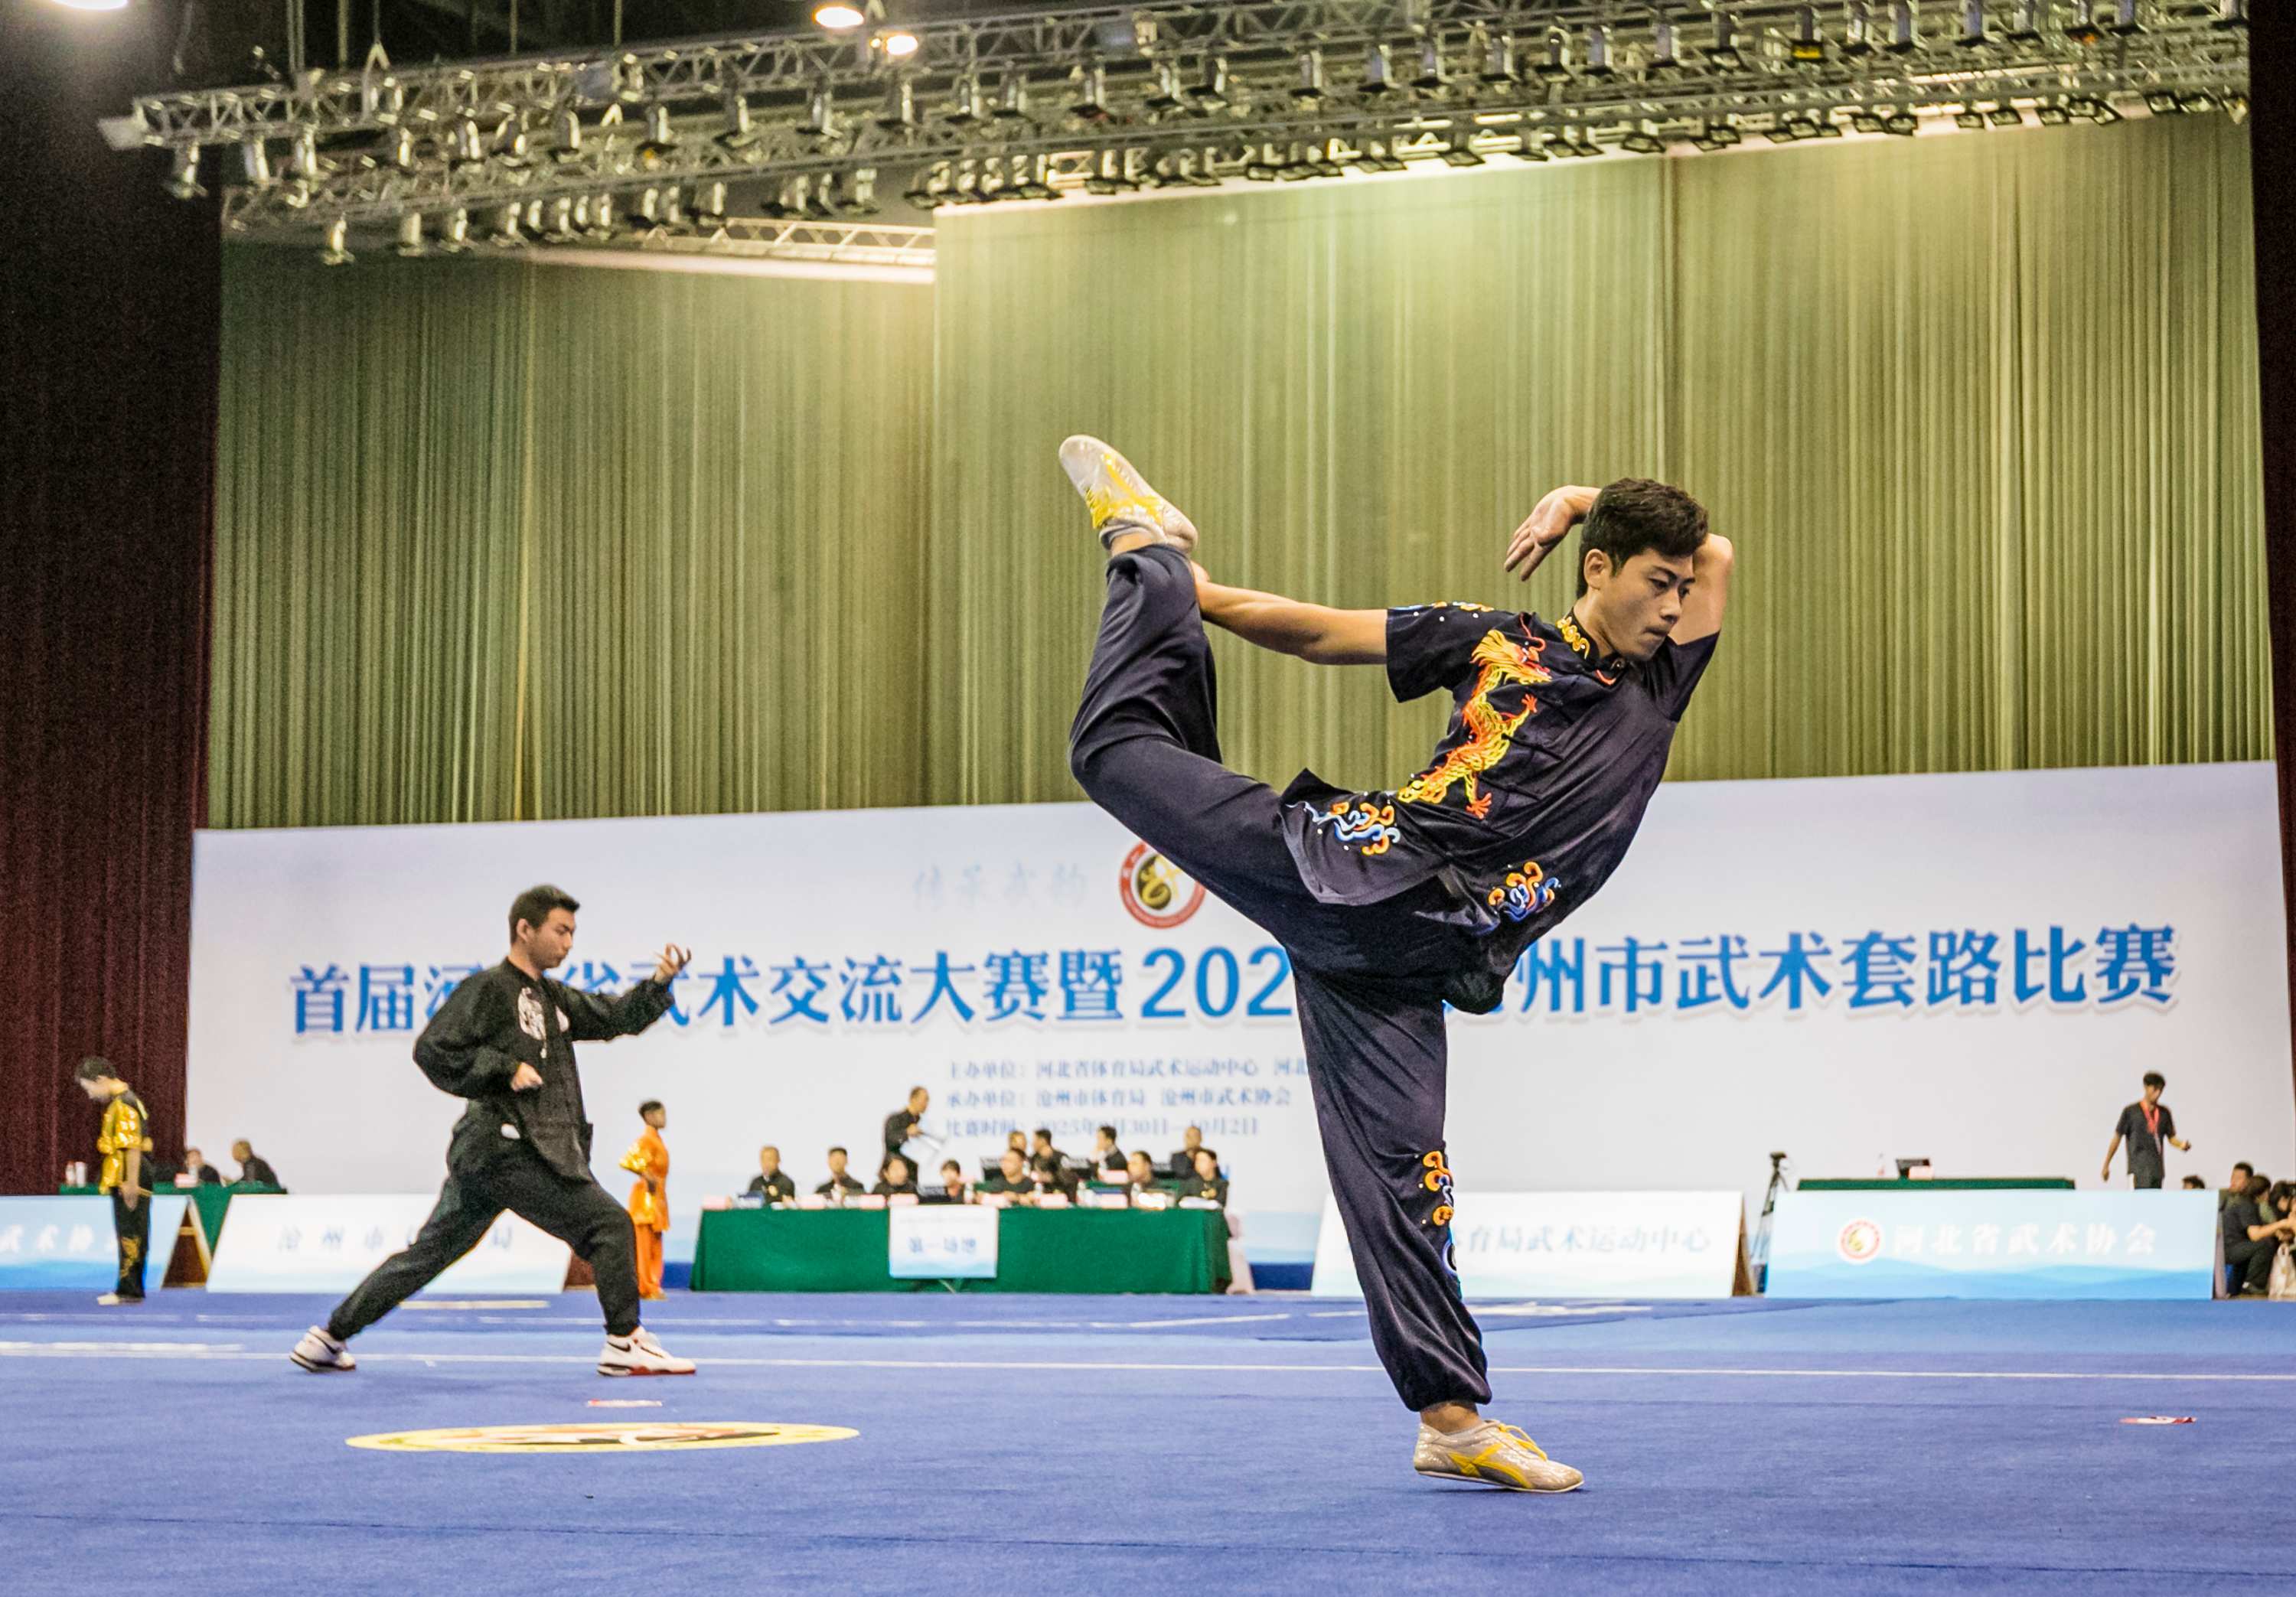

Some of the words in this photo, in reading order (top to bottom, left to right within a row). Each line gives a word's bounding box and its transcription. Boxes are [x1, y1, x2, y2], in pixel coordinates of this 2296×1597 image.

[278, 1226, 514, 1252] 沧州市局
[1893, 1222, 2157, 1256] 河北省武术协会
